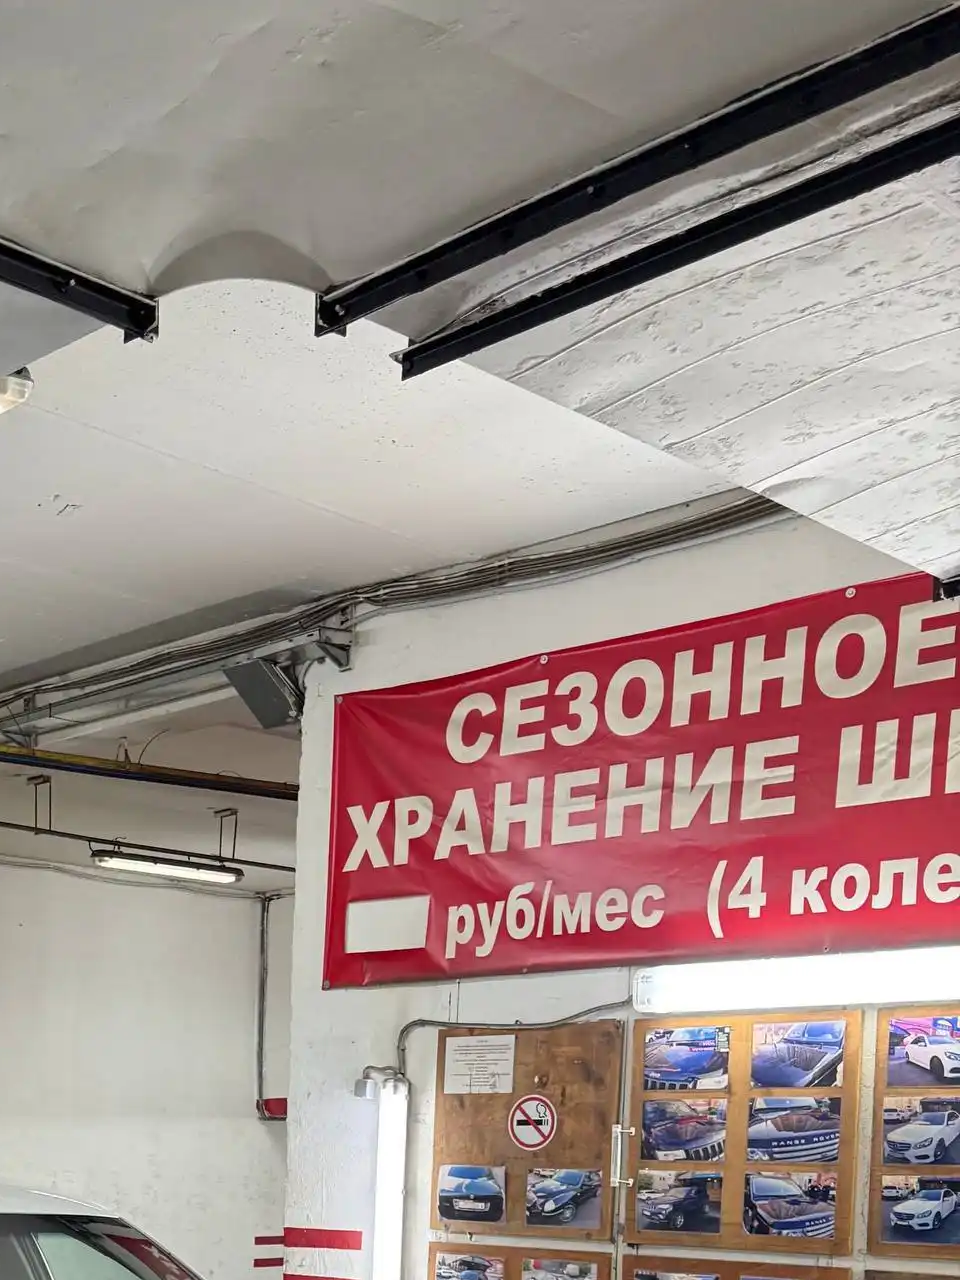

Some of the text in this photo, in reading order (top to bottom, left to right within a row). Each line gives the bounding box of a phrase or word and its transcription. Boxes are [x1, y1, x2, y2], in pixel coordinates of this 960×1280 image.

[445, 600, 959, 764] СЕЗОННОЕ
[343, 709, 960, 872] ХРАНЕНИЕ Ш
[445, 881, 665, 960] руб/мес
[707, 857, 767, 939] (4
